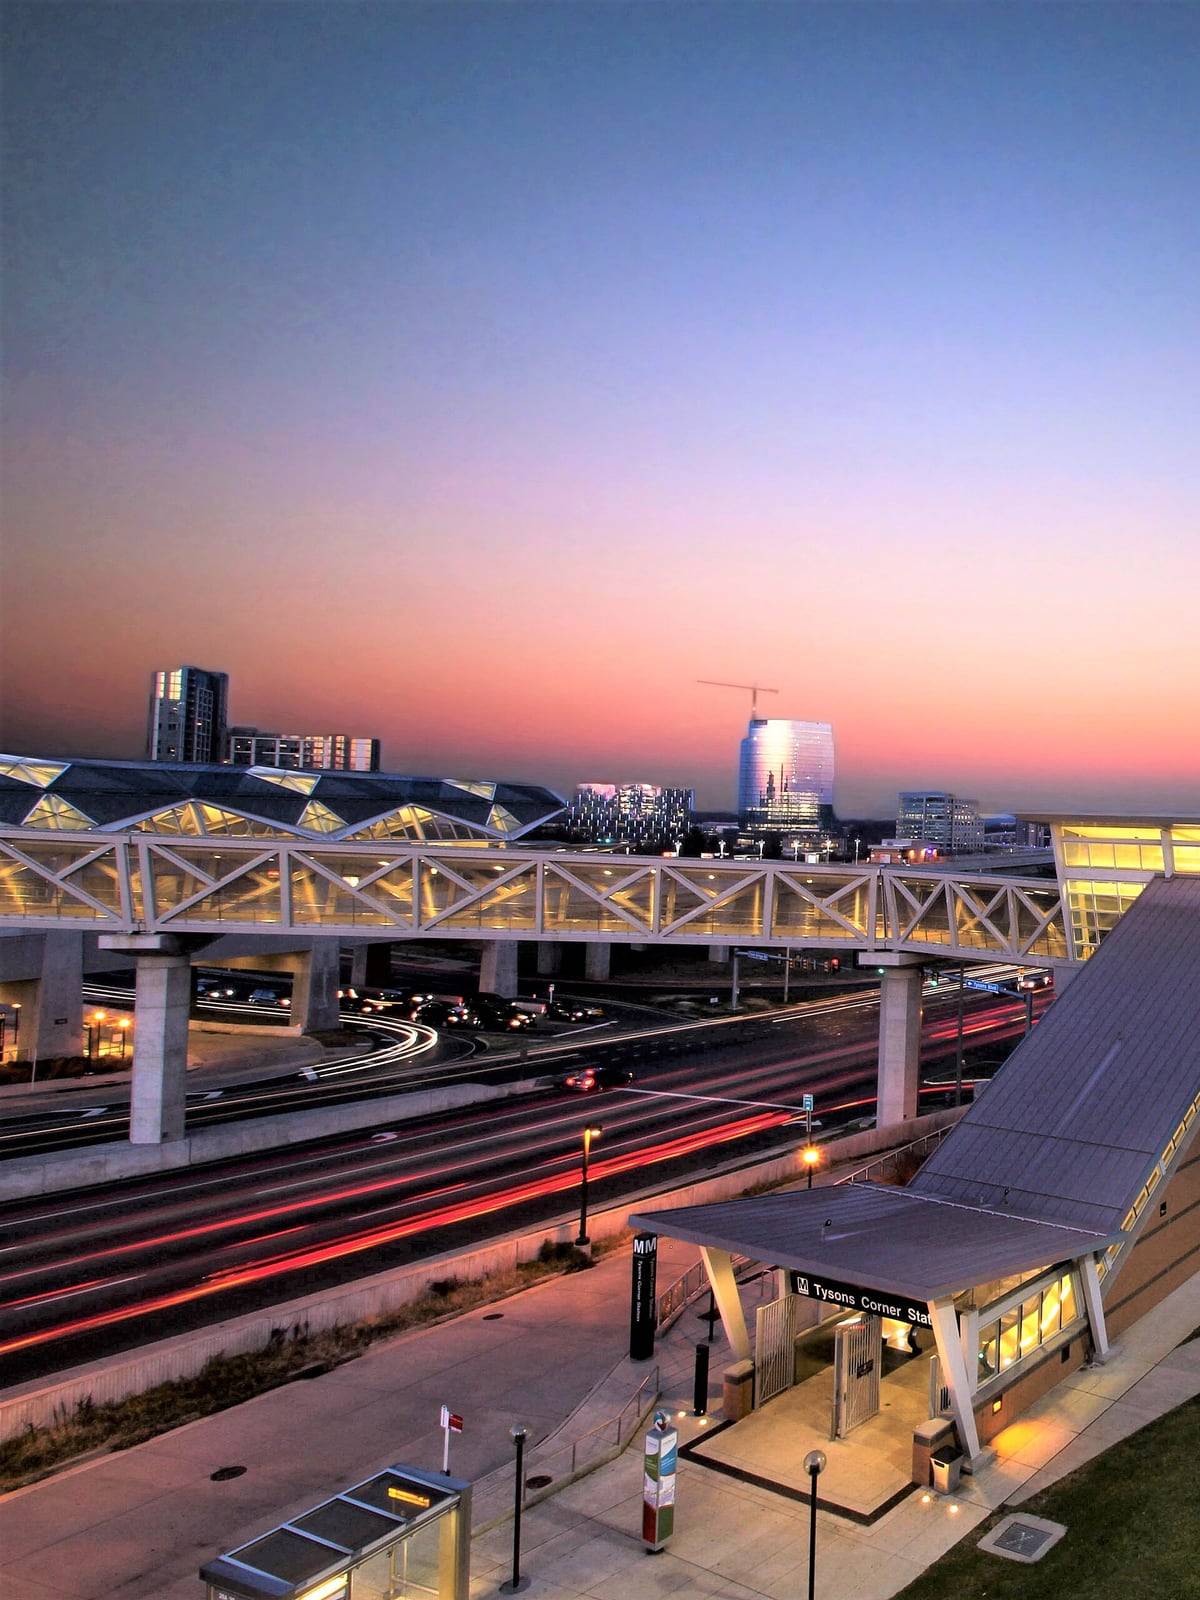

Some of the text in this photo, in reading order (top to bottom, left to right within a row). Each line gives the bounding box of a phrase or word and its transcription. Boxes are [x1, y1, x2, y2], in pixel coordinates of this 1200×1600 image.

[634, 1239, 644, 1254] M
[813, 1283, 856, 1305] Tysons
[861, 1296, 902, 1317] Corner
